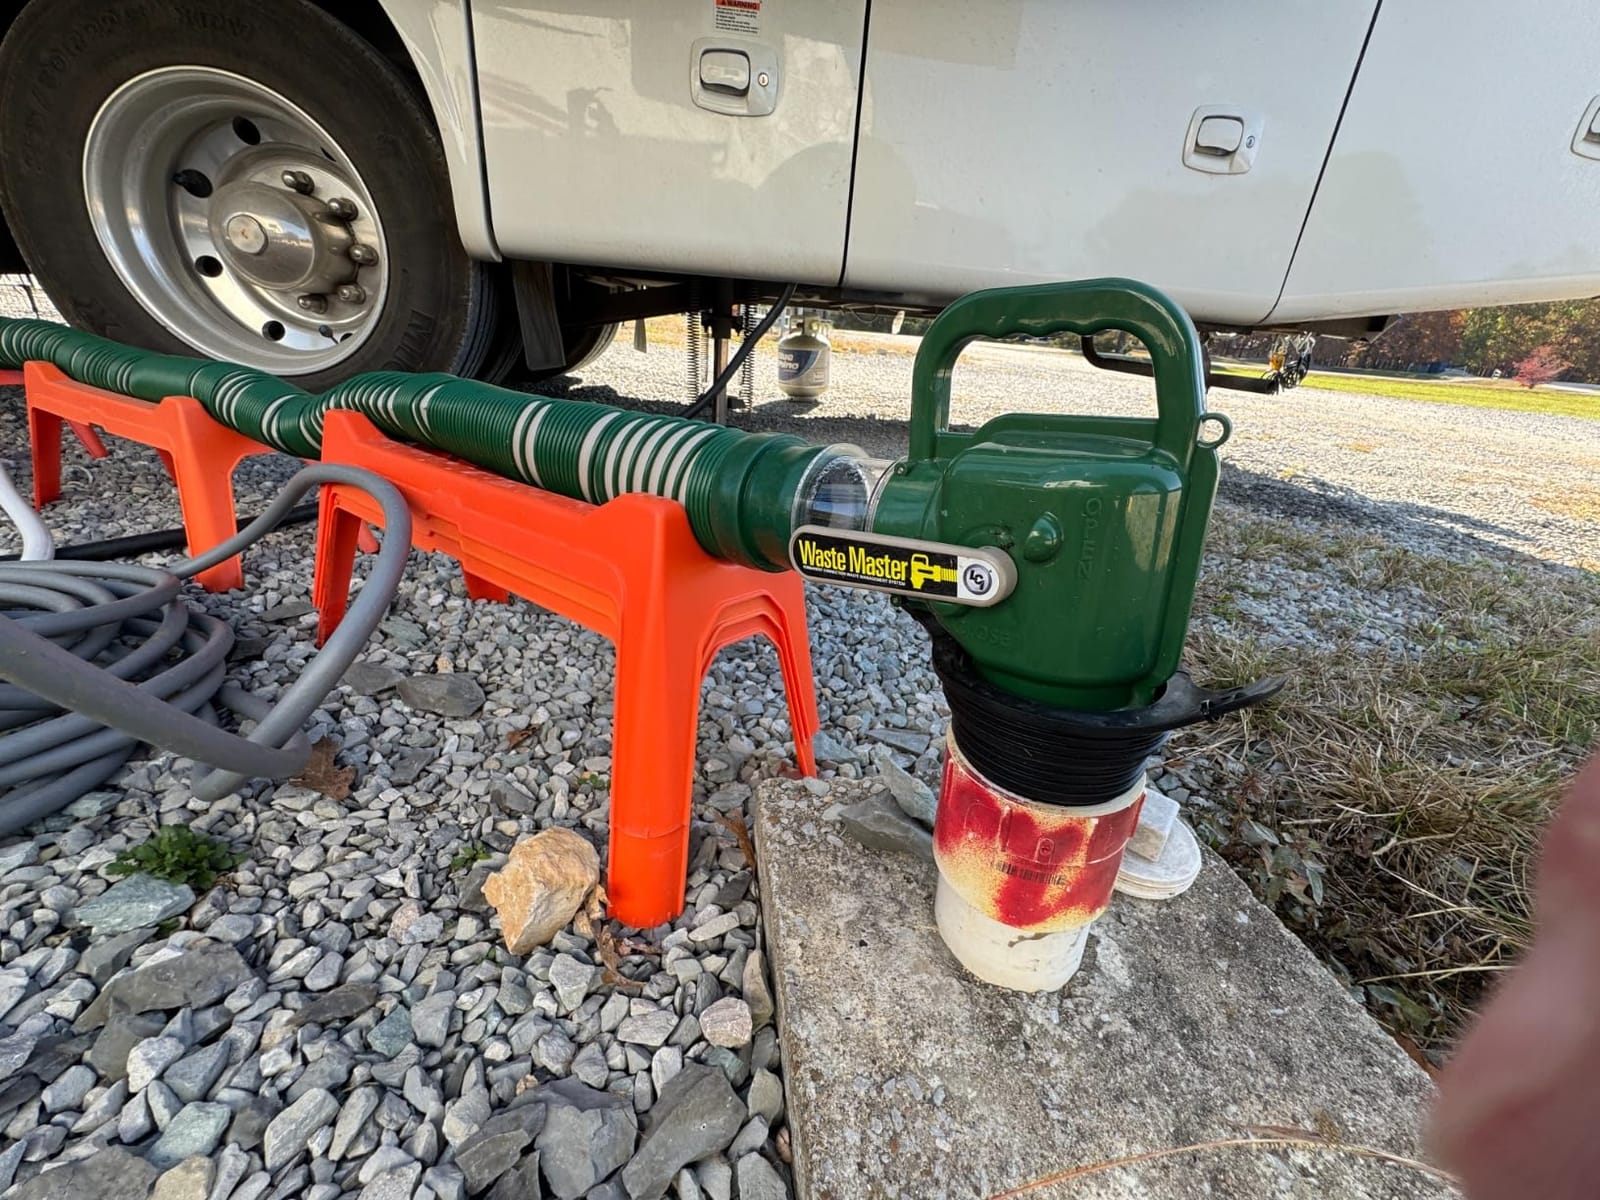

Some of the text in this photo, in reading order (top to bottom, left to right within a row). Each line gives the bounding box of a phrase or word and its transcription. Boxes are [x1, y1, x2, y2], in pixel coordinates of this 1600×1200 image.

[727, 0, 757, 9] WARNING
[798, 539, 908, 581] Waste Master
